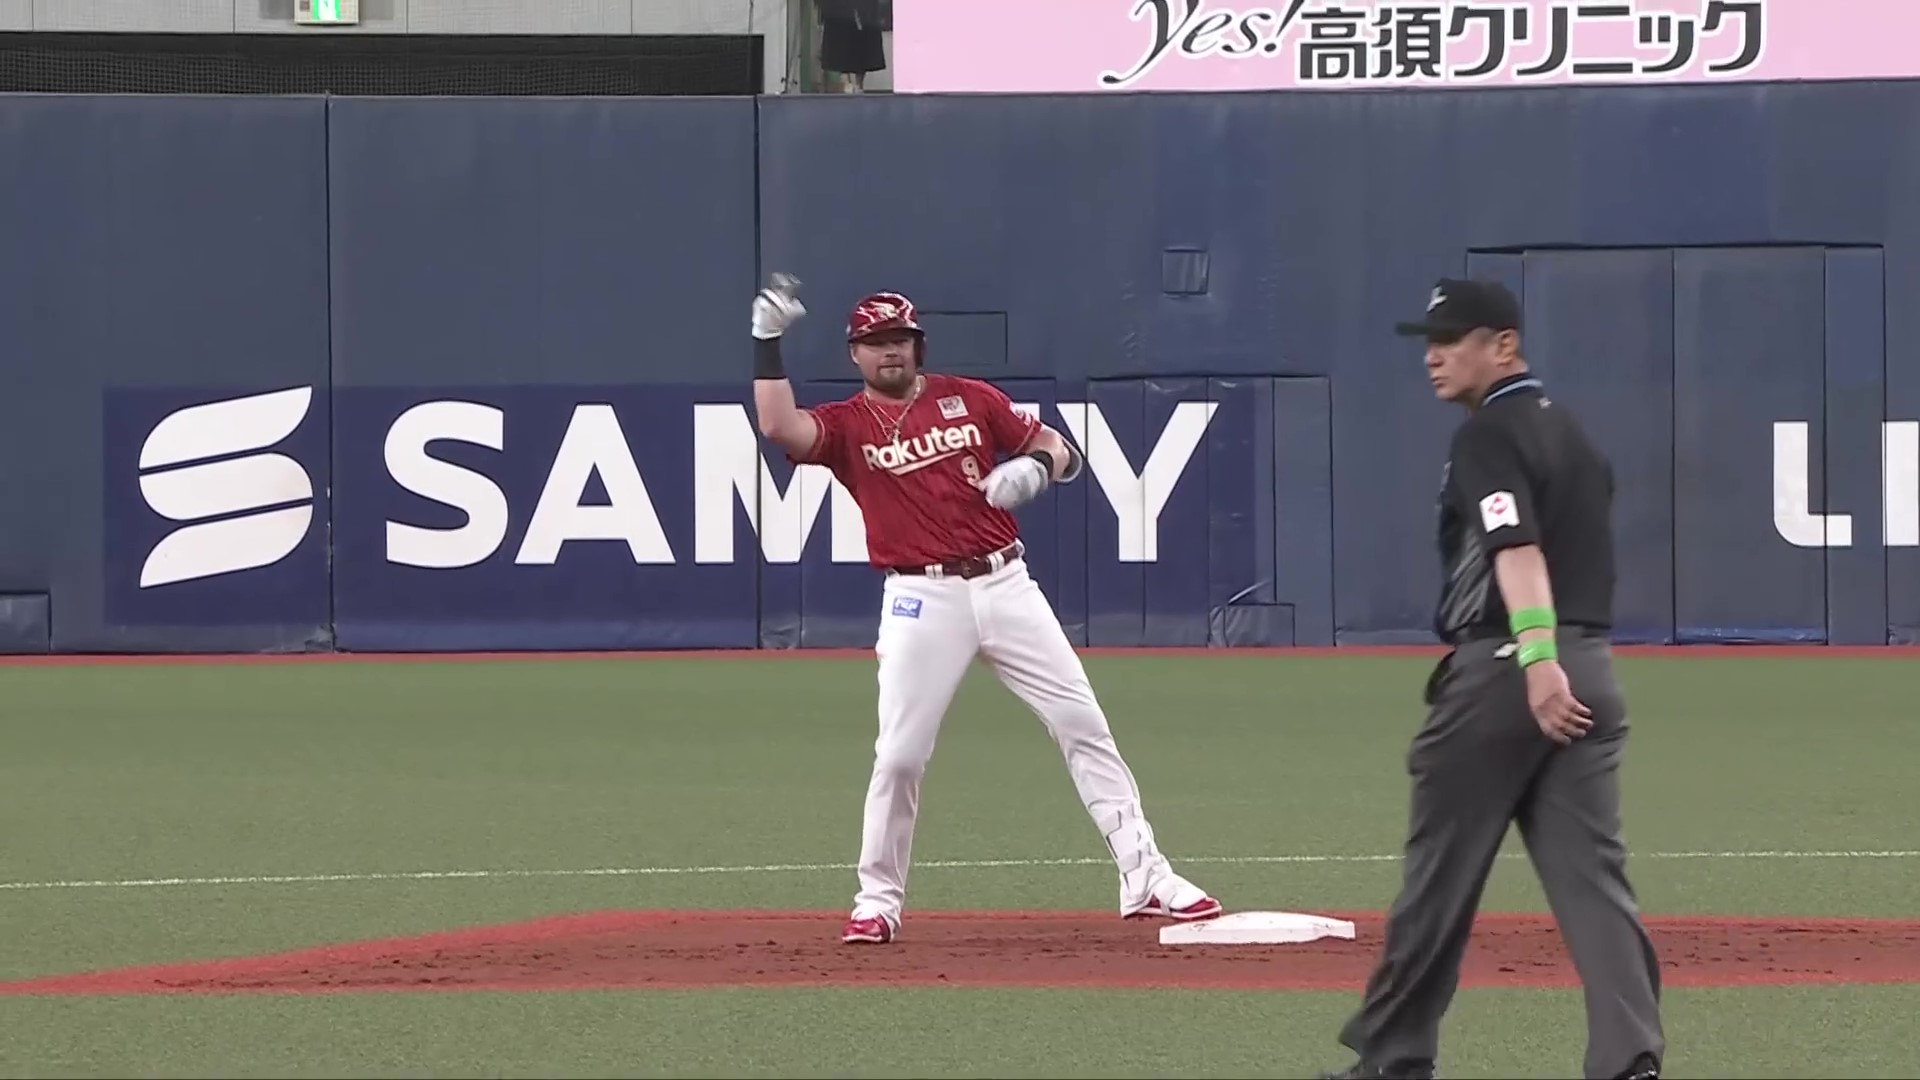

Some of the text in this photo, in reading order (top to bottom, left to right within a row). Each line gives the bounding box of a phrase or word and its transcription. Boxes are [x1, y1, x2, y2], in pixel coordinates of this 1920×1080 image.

[1299, 1, 1762, 79] 高須クリニック
[384, 401, 1219, 568] SAMY
[861, 422, 982, 472] Rakuten
